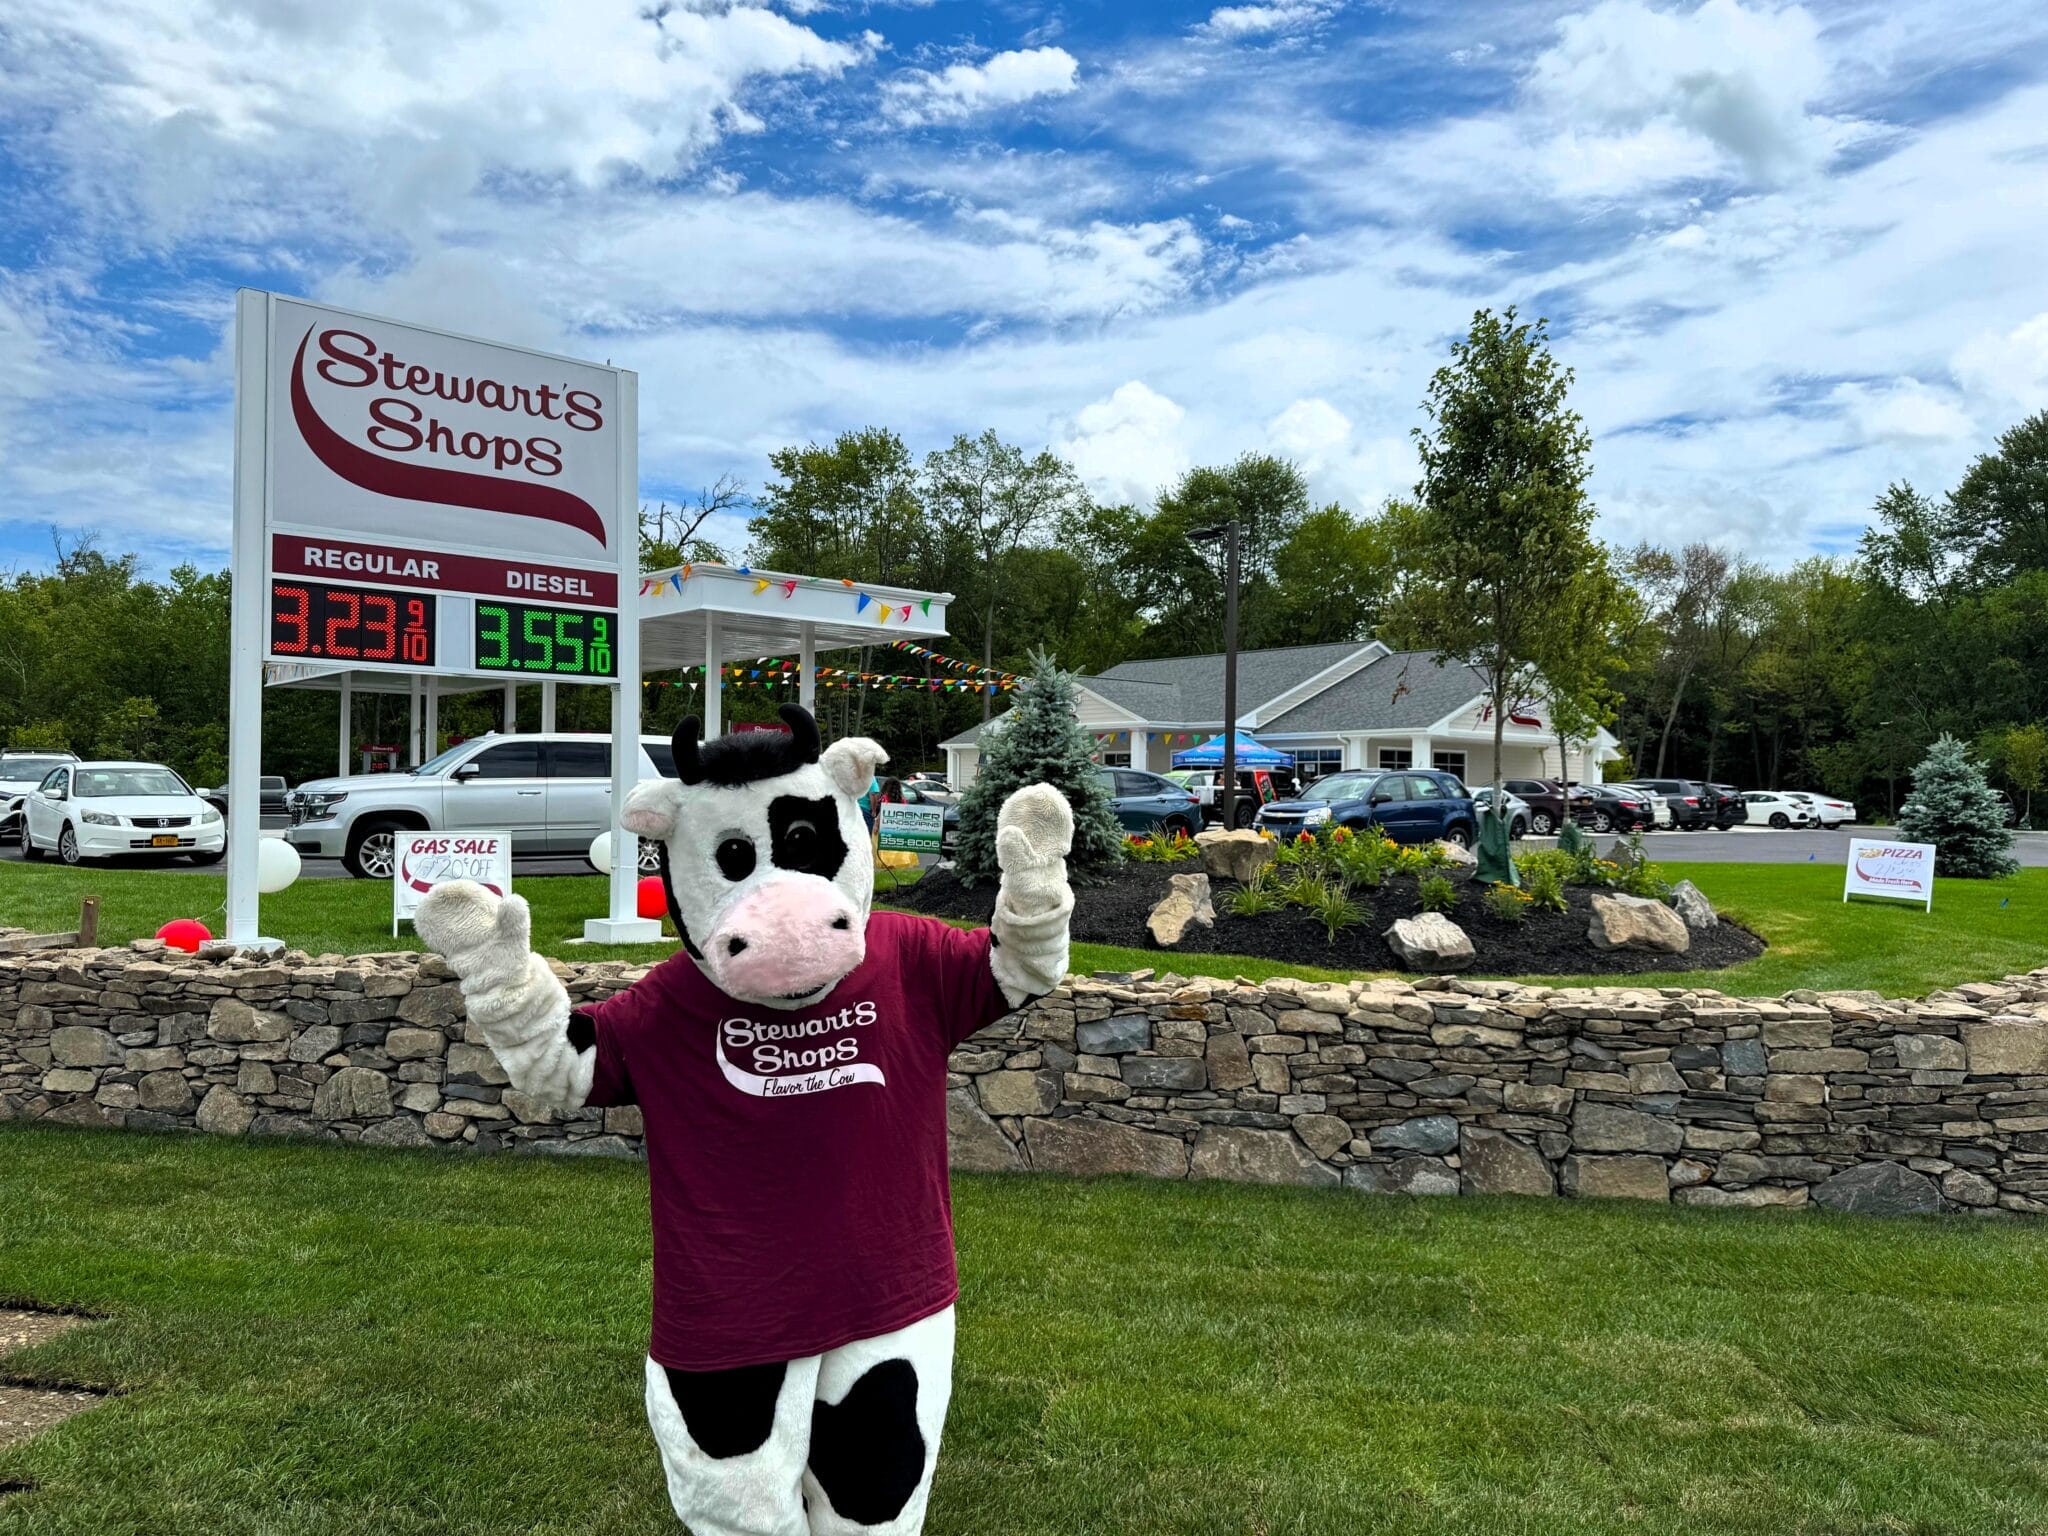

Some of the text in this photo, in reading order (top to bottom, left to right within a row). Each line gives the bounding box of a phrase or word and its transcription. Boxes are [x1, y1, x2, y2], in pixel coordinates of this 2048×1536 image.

[304, 546, 439, 580] REGULAR
[506, 570, 594, 598] DIESEL
[273, 585, 397, 659] 3.23
[479, 606, 584, 672] 3.55
[882, 810, 941, 821] WAGNER
[882, 819, 941, 828] LANDSCAPING
[411, 839, 498, 854] GAS SALE
[1881, 848, 1922, 859] PIZZA
[470, 859, 493, 877] OFF
[763, 1068, 856, 1096] Flavor the Cow
